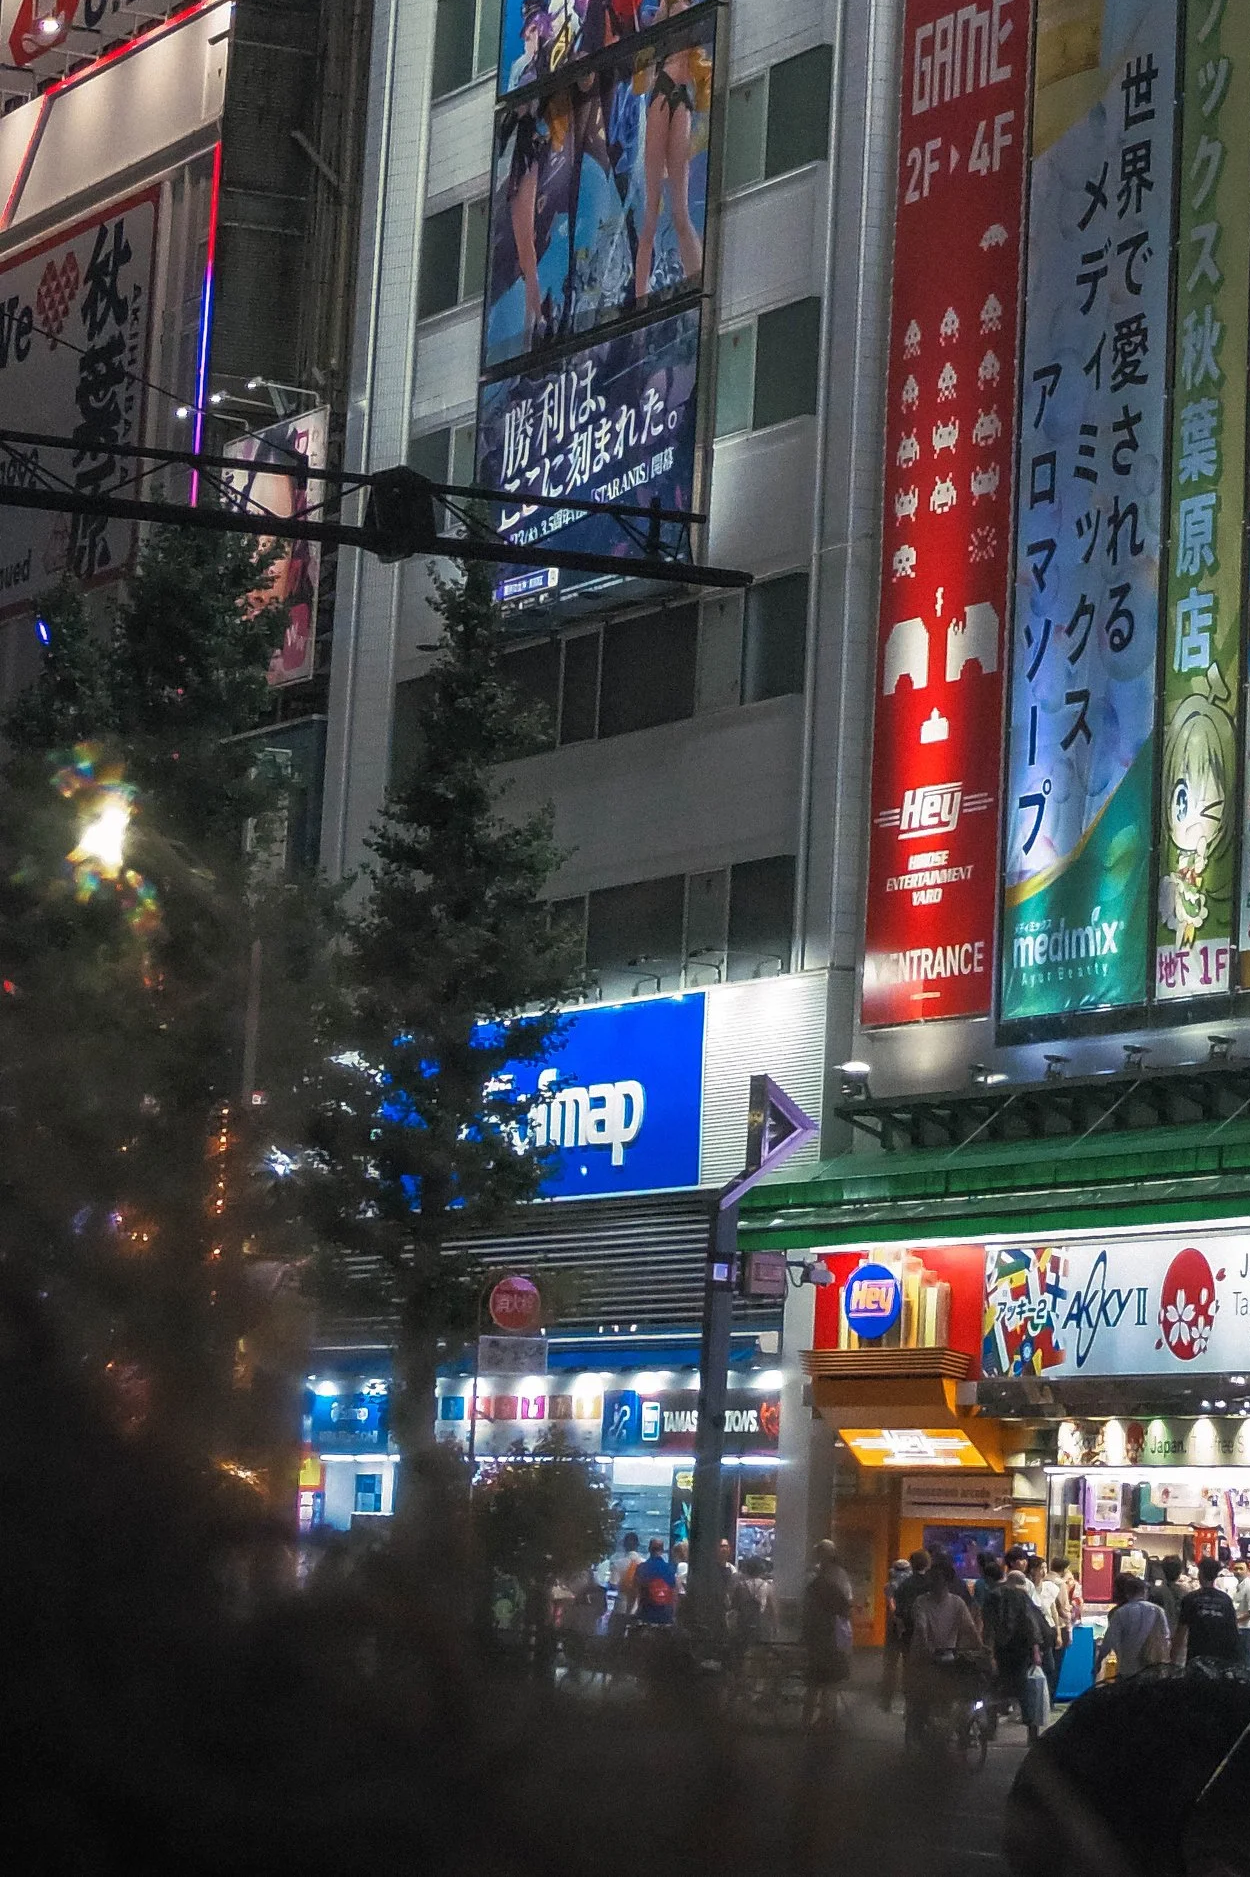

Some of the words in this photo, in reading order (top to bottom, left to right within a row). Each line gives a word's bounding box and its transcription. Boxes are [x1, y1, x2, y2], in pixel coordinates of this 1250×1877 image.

[904, 137, 942, 206] 2F
[968, 110, 1015, 176] 4F
[1106, 53, 1160, 654] 世界で愛される
[501, 360, 606, 484] 勝利は、
[1059, 160, 1116, 751] メディミックス
[1018, 362, 1064, 856] アロマソープ
[898, 782, 963, 840] Hey
[886, 865, 974, 893] ENTERTAINMENT
[912, 888, 943, 907] YARD
[1013, 906, 1118, 969] medimix
[1159, 950, 1190, 988] 地下
[1199, 946, 1229, 986] 1F
[849, 1279, 895, 1317] Hey
[996, 1298, 1048, 1322] アッキー2
[663, 1410, 699, 1432] TAMAS
[1150, 1435, 1187, 1458] Japan.
